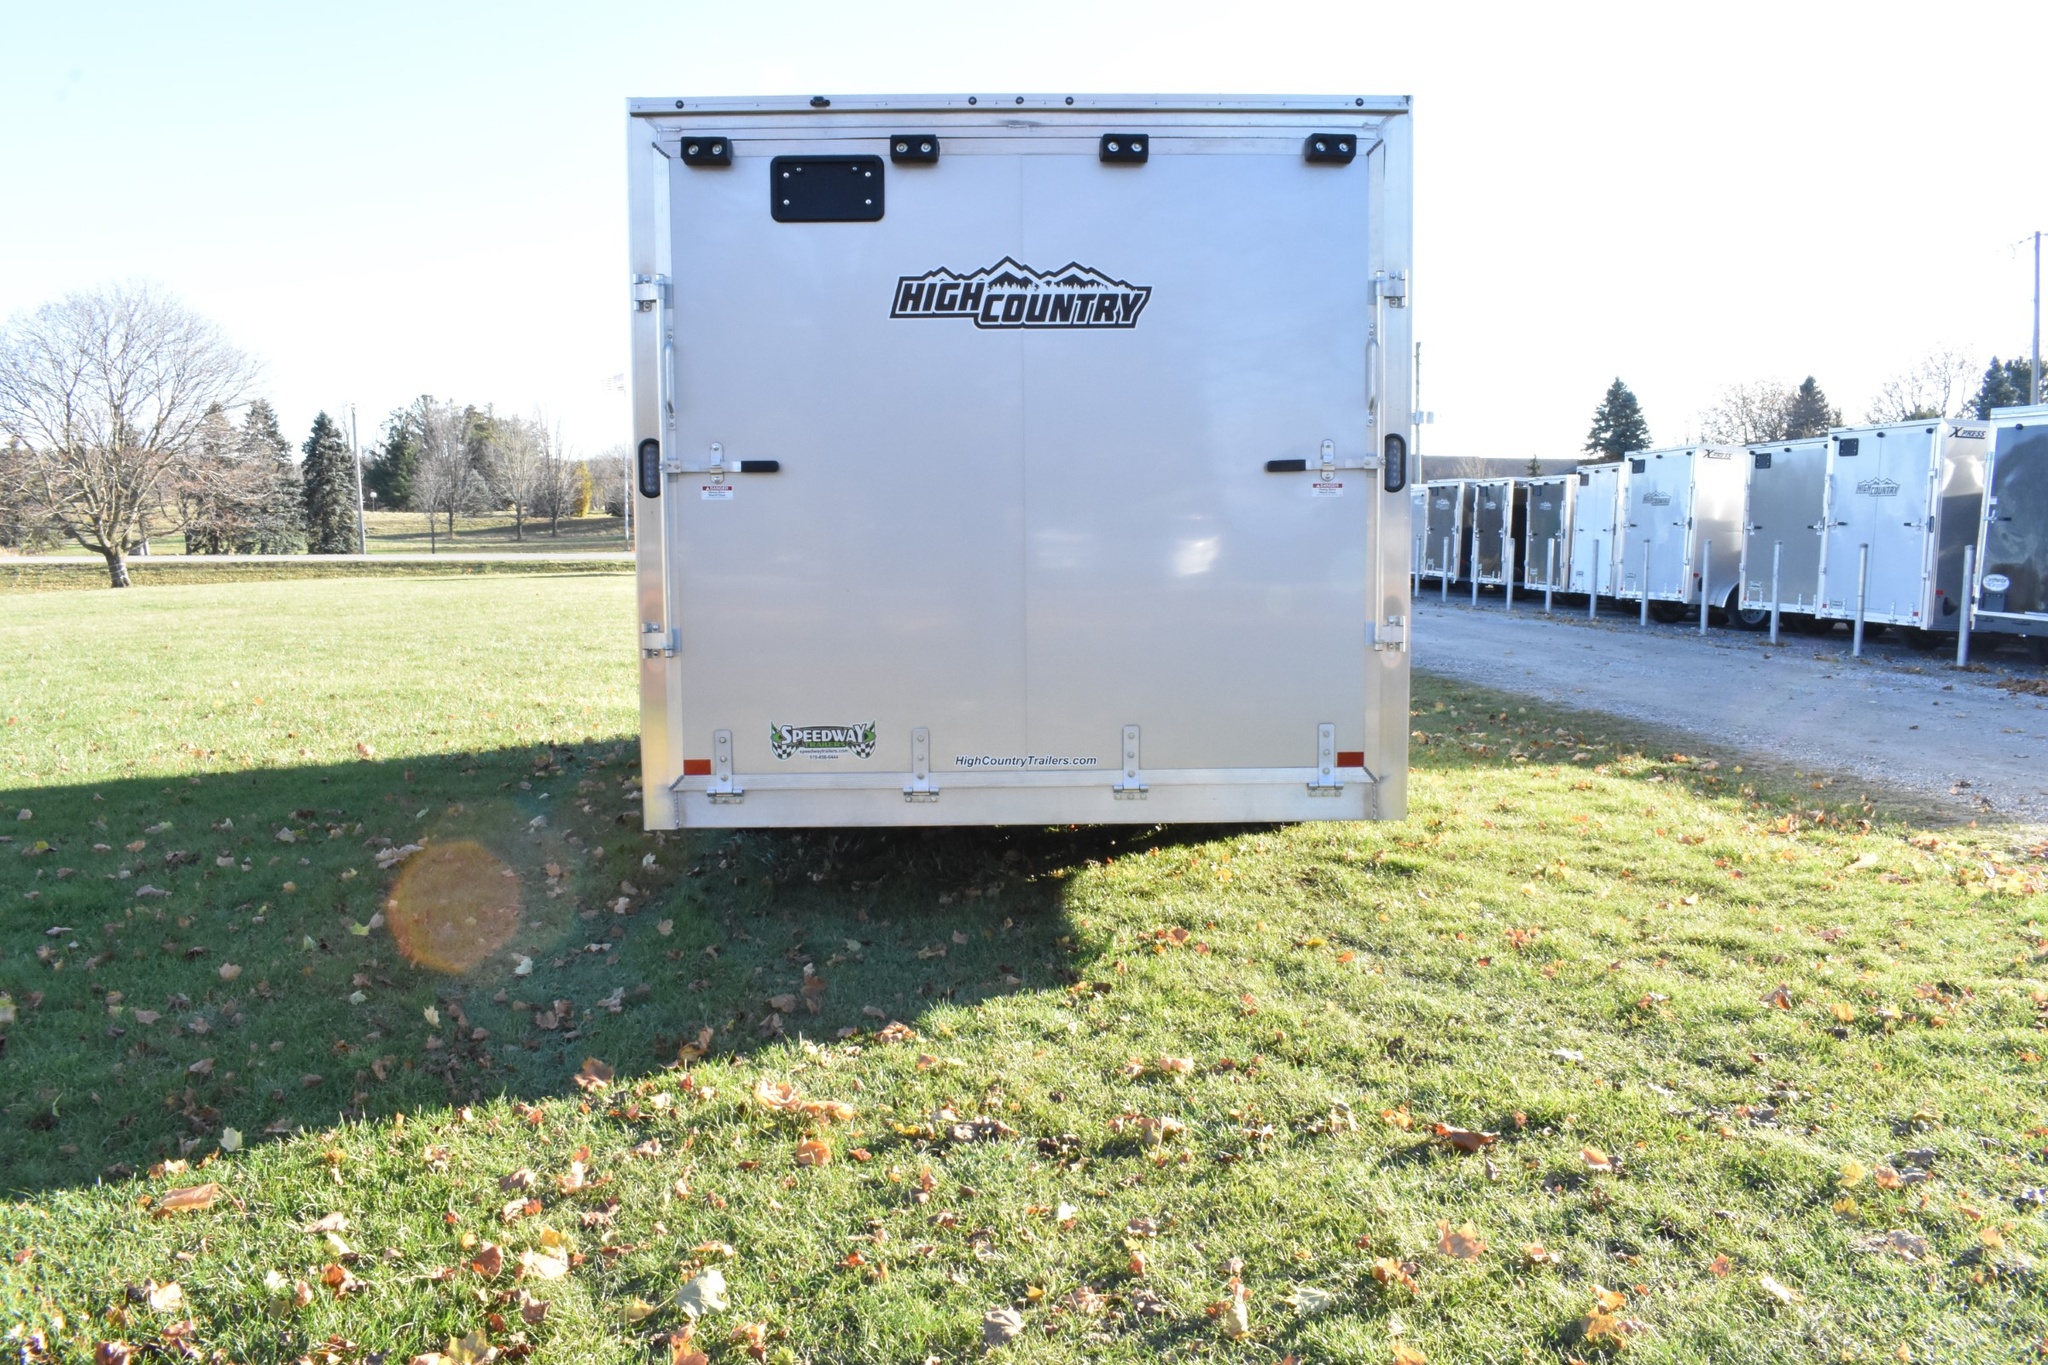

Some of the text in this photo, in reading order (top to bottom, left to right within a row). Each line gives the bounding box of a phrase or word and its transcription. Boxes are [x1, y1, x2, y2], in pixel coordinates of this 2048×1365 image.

[899, 282, 1144, 323] HIGH COUNTRY
[781, 724, 866, 744] SPEEDWAY
[955, 755, 1097, 767] HighCountryTrailers.com
